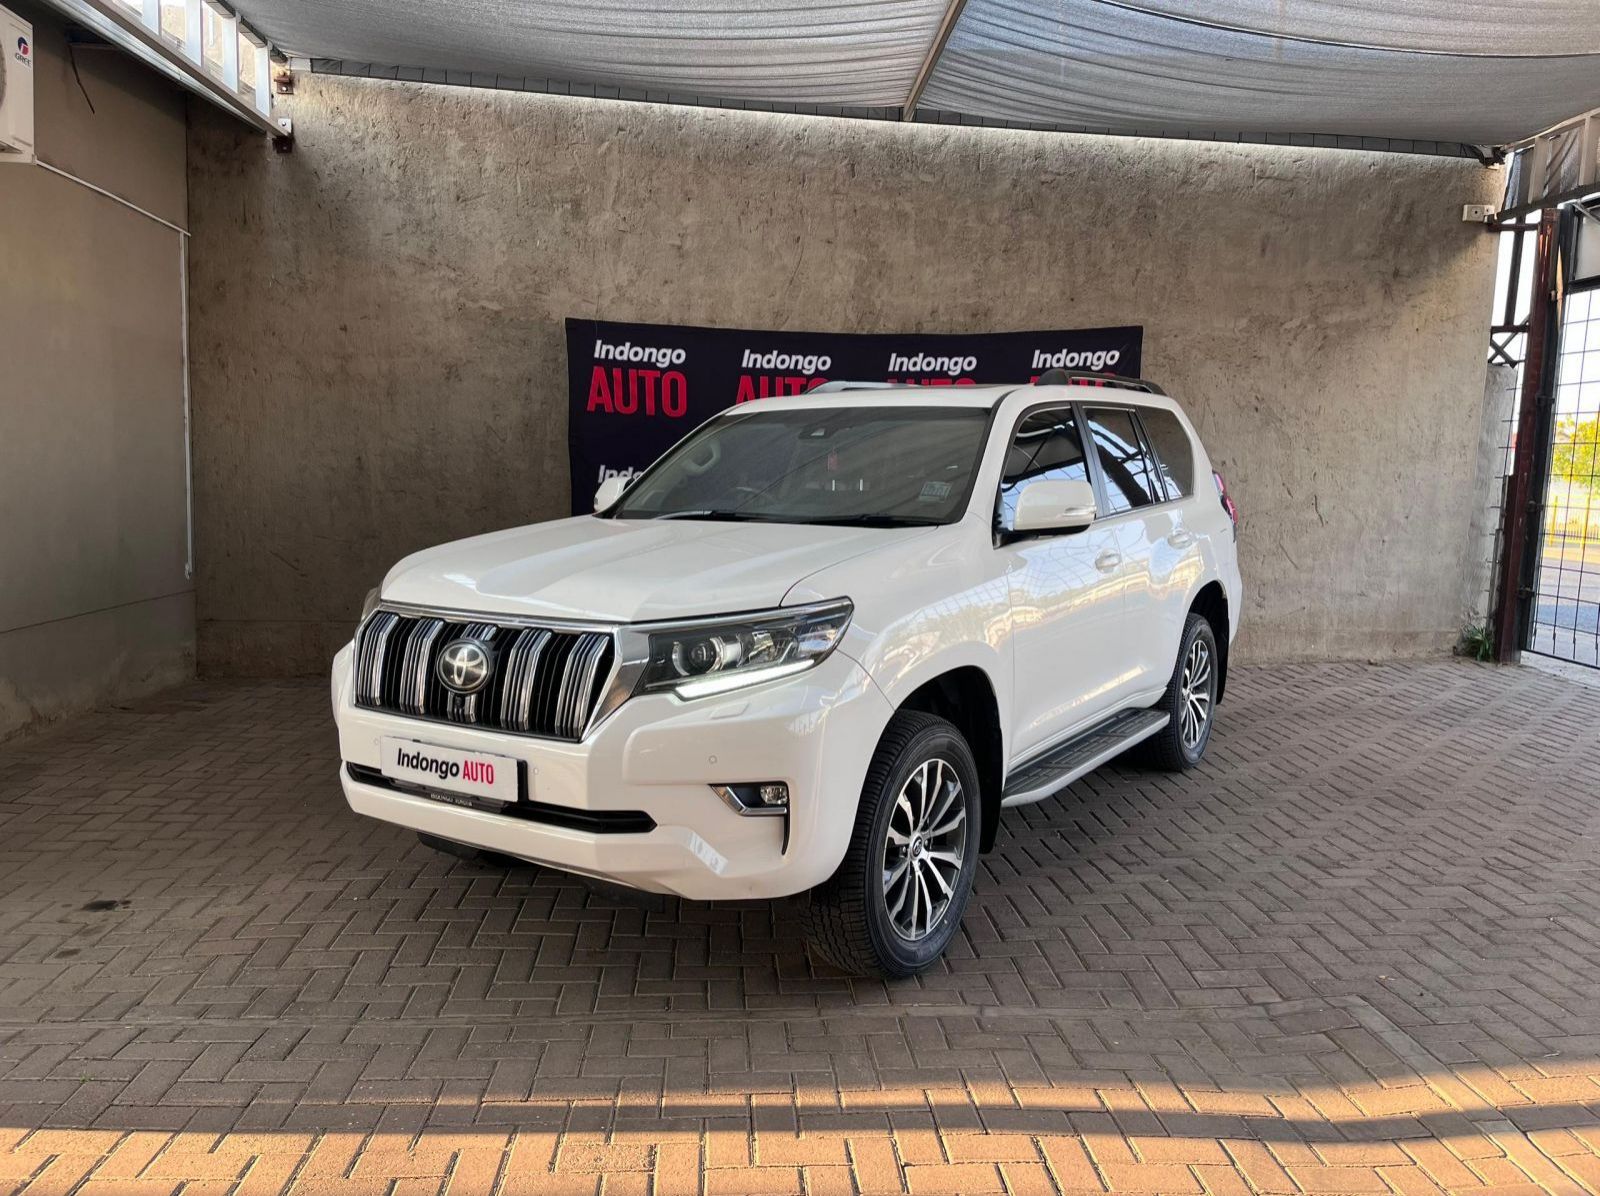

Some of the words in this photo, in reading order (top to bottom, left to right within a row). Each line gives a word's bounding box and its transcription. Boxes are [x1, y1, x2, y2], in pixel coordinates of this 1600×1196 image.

[593, 339, 687, 368] Indongo
[741, 349, 832, 375] Indongo
[887, 352, 978, 376] Indongo
[1031, 348, 1120, 371] Indongo
[586, 366, 687, 418] AUTO
[397, 748, 460, 779] Indongo
[462, 760, 495, 785] AUTO
